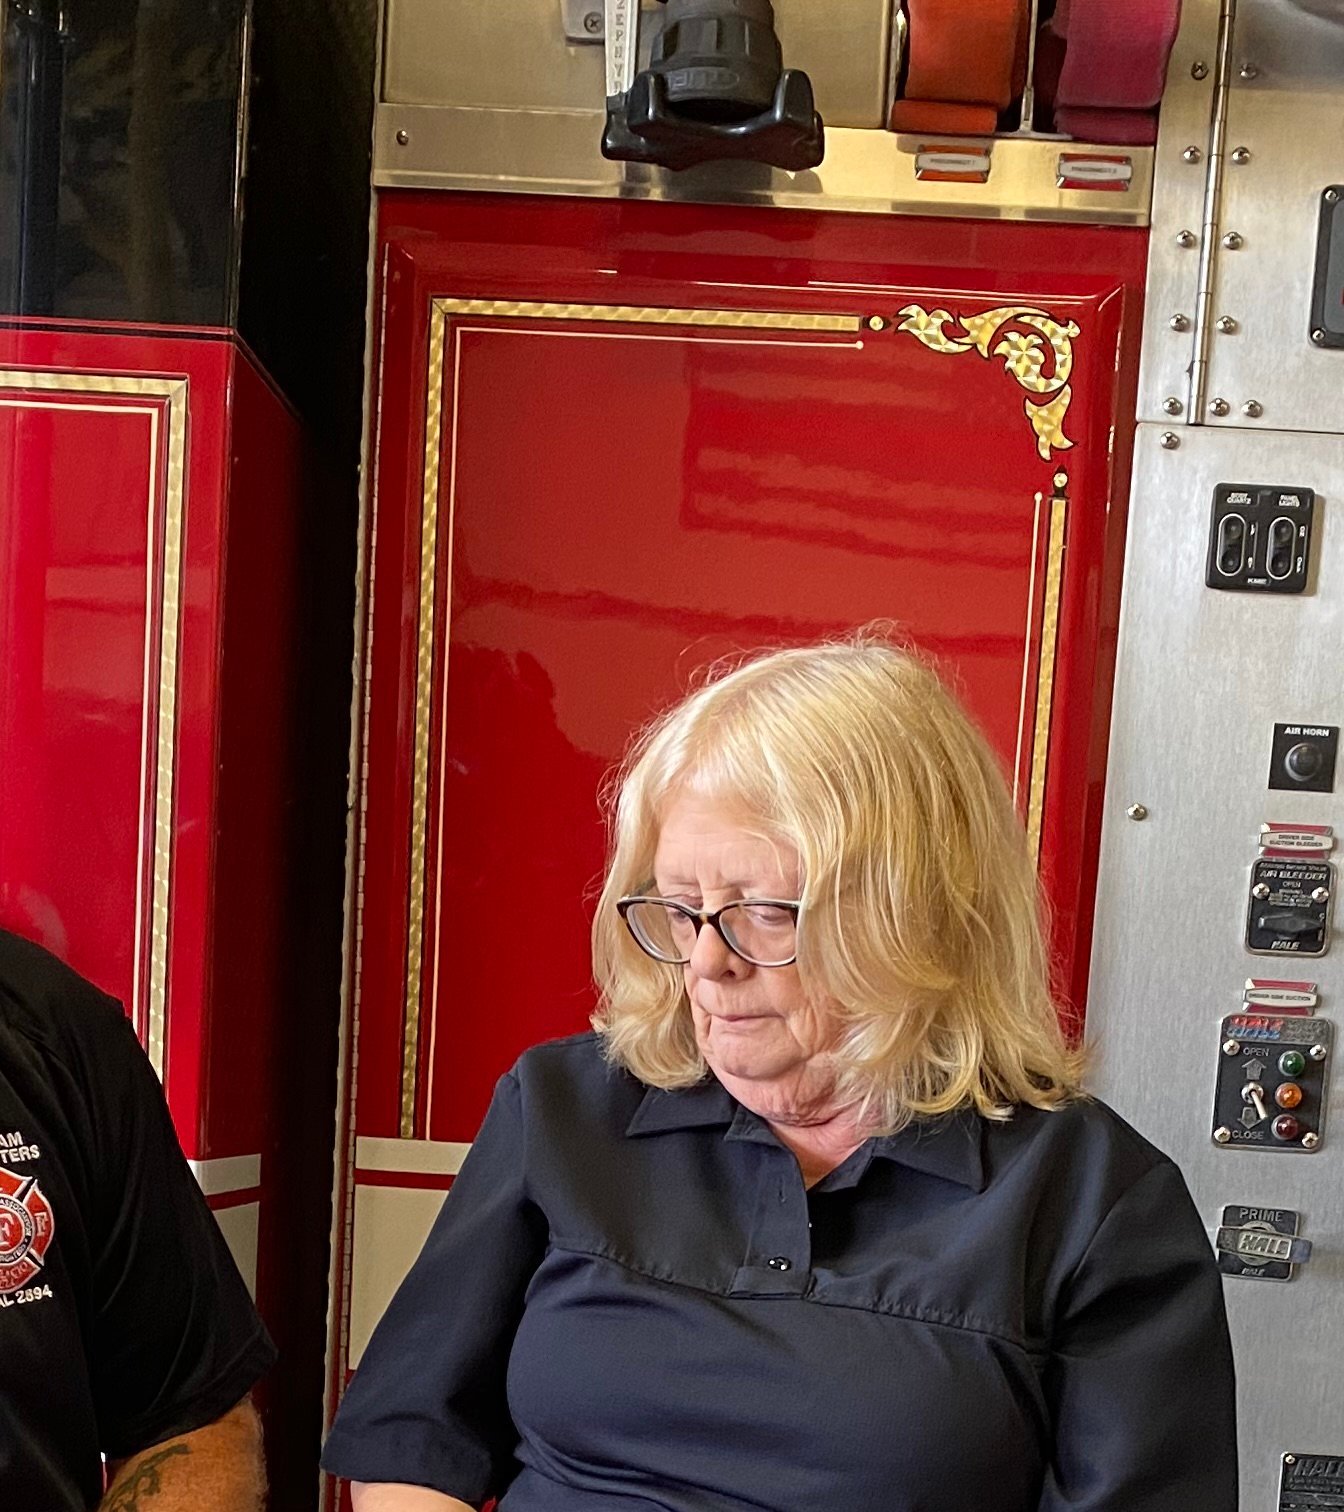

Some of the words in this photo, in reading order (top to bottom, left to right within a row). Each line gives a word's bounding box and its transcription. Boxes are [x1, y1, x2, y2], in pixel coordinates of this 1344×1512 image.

[1284, 726, 1301, 735] AIR
[1302, 727, 1330, 737] HORN
[1259, 870, 1277, 878] AIR
[1282, 880, 1301, 888] OPEN
[1242, 1047, 1270, 1057] OPEN
[1231, 1131, 1264, 1140] CLOSE
[1239, 1207, 1284, 1222] PRIME
